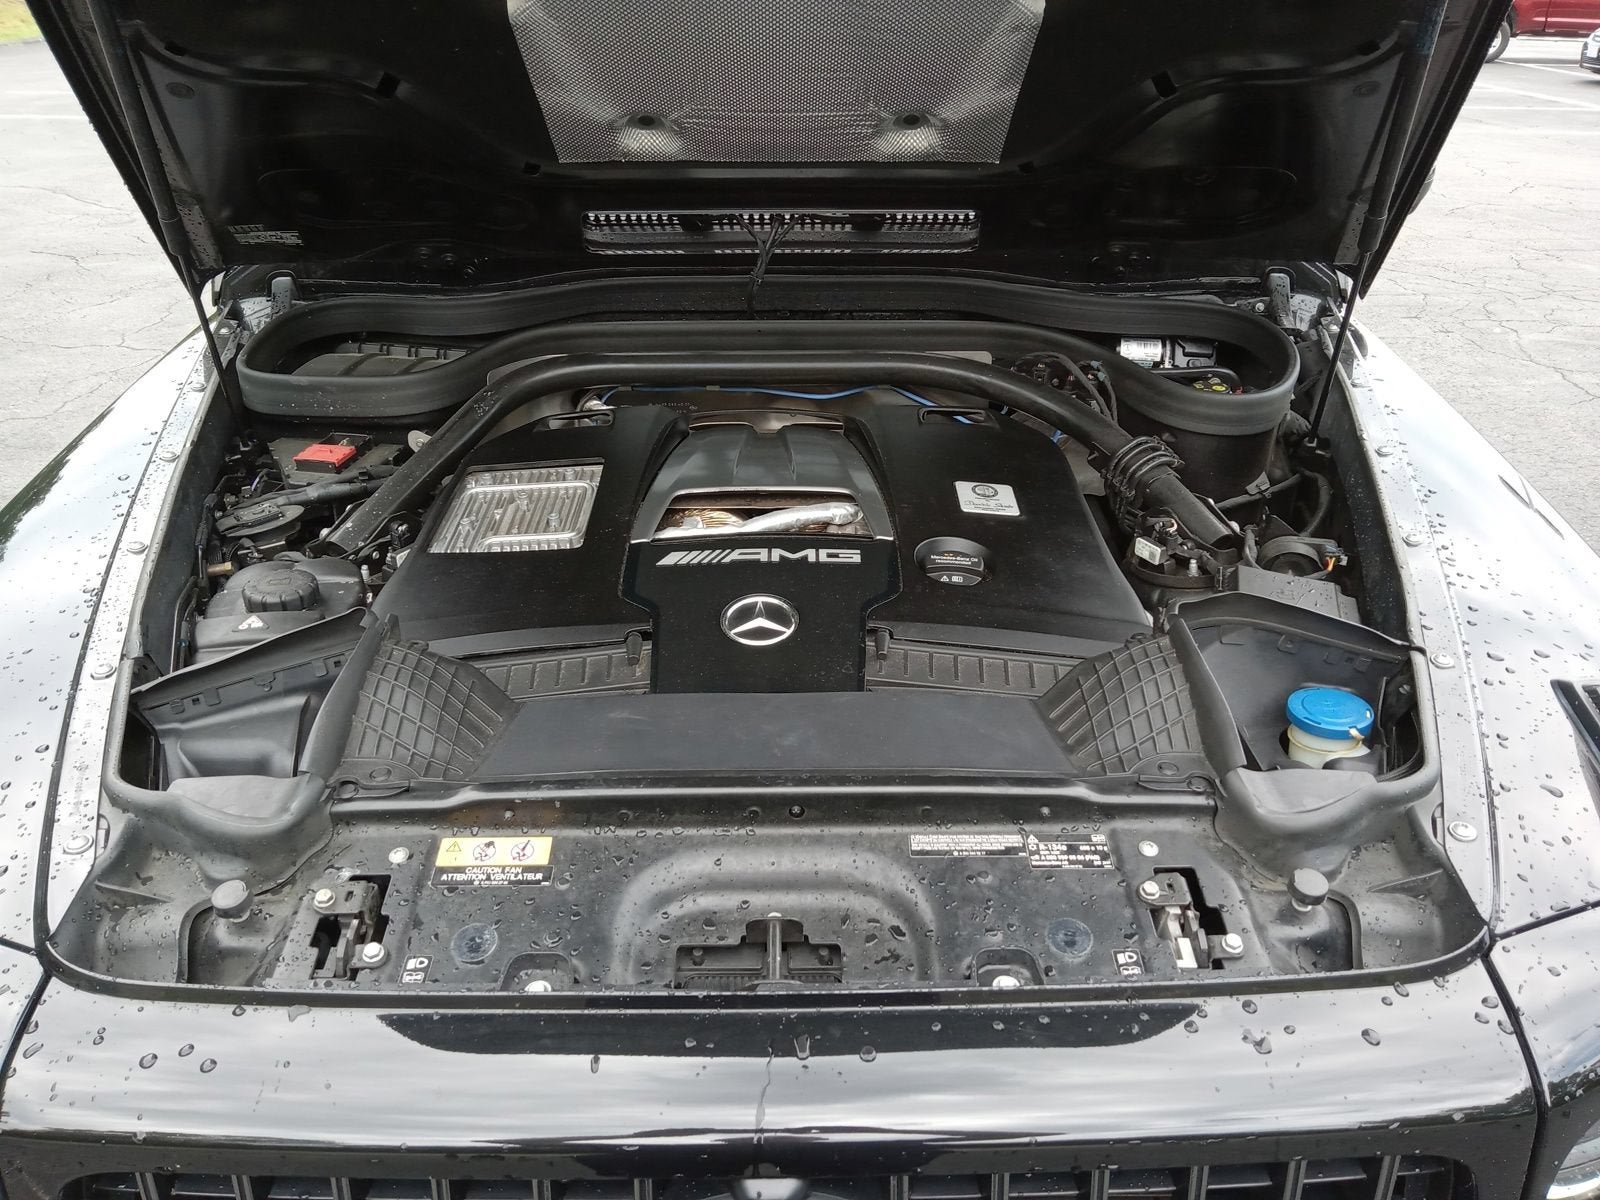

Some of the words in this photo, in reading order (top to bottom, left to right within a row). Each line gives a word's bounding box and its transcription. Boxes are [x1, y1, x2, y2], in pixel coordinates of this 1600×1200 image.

[720, 548, 862, 564] AMG
[465, 866, 502, 874] CAUTION
[504, 866, 523, 874] FAN
[440, 873, 487, 881] ATTENTION
[490, 873, 543, 881] VENTILATEUR
